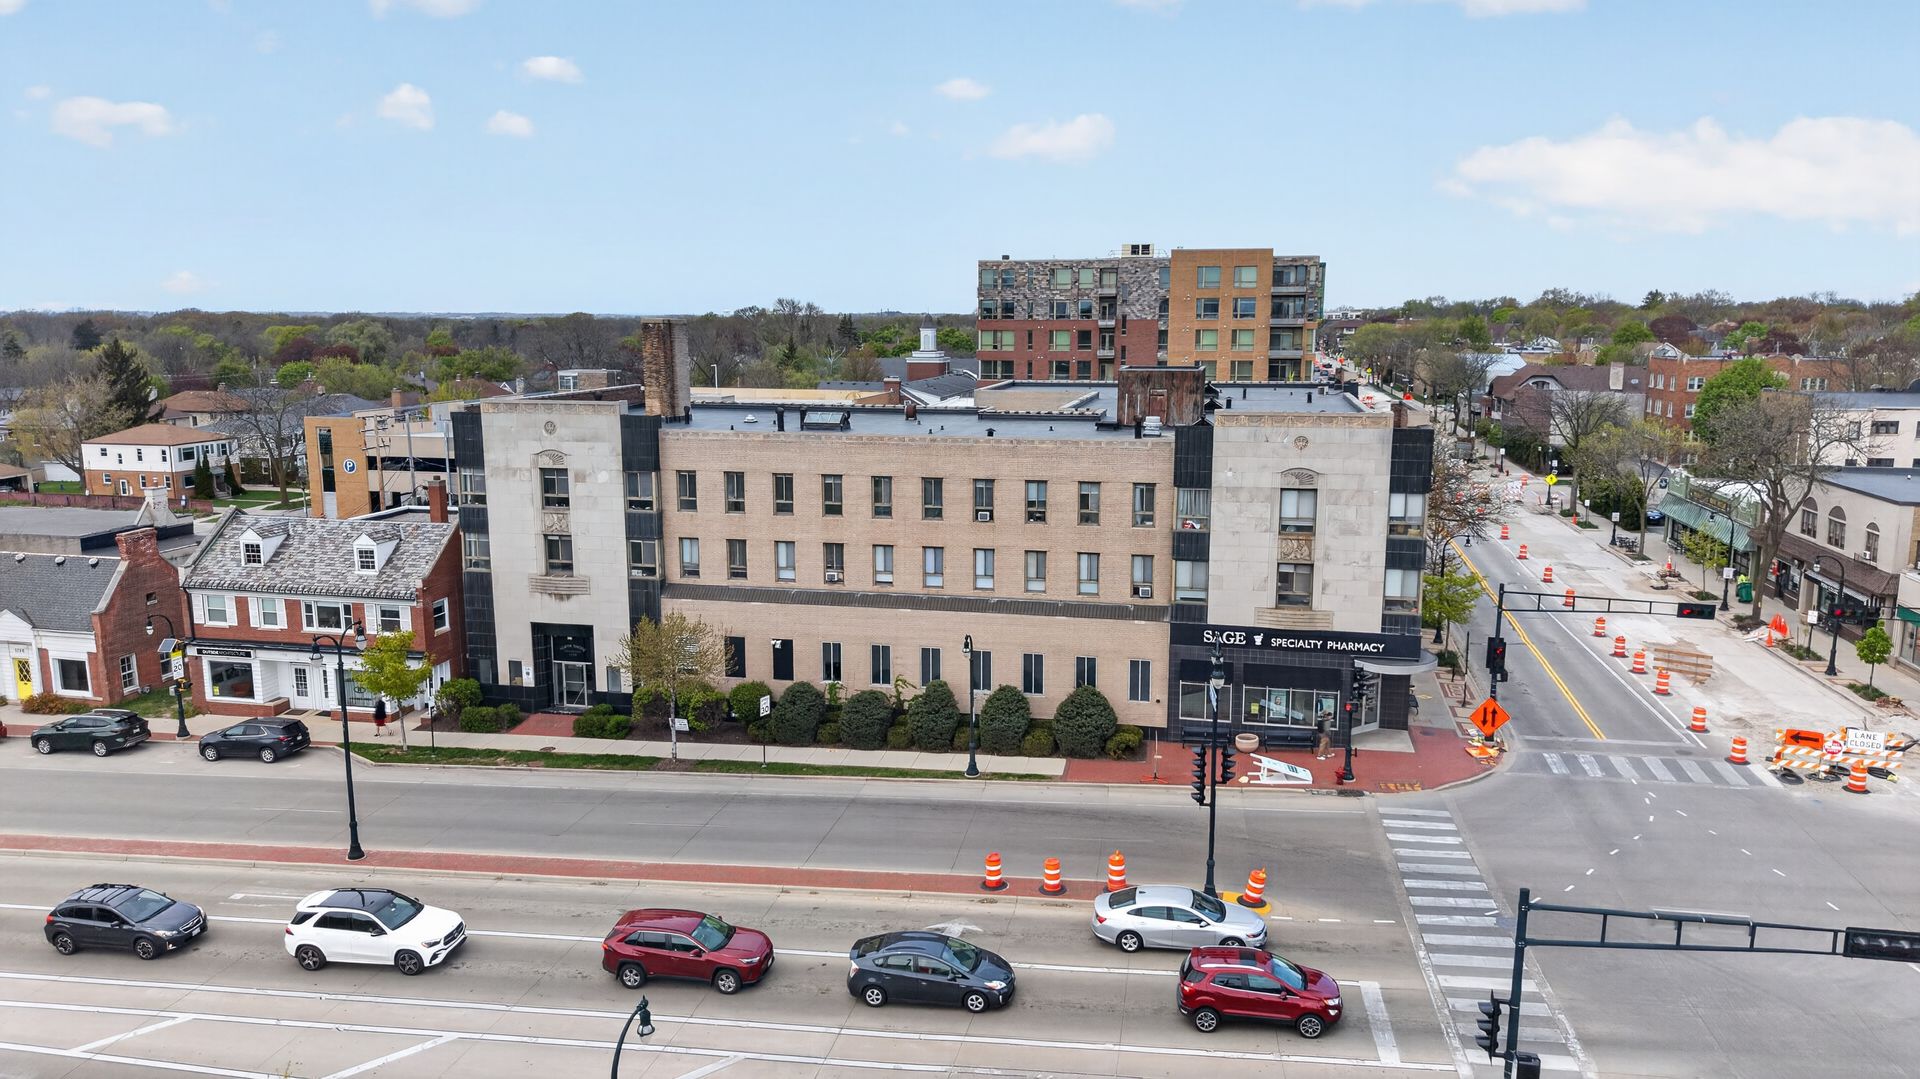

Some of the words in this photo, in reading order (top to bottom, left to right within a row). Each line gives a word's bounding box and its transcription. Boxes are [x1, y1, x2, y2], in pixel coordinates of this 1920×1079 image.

[346, 461, 354, 471] P
[1203, 630, 1246, 645] SAGE
[1271, 638, 1322, 649] SPECIALTY
[1327, 641, 1385, 652] PHARMACY
[173, 664, 182, 672] 20
[761, 705, 770, 715] 30
[1854, 732, 1878, 741] LANE
[1850, 740, 1882, 749] CLOSED
